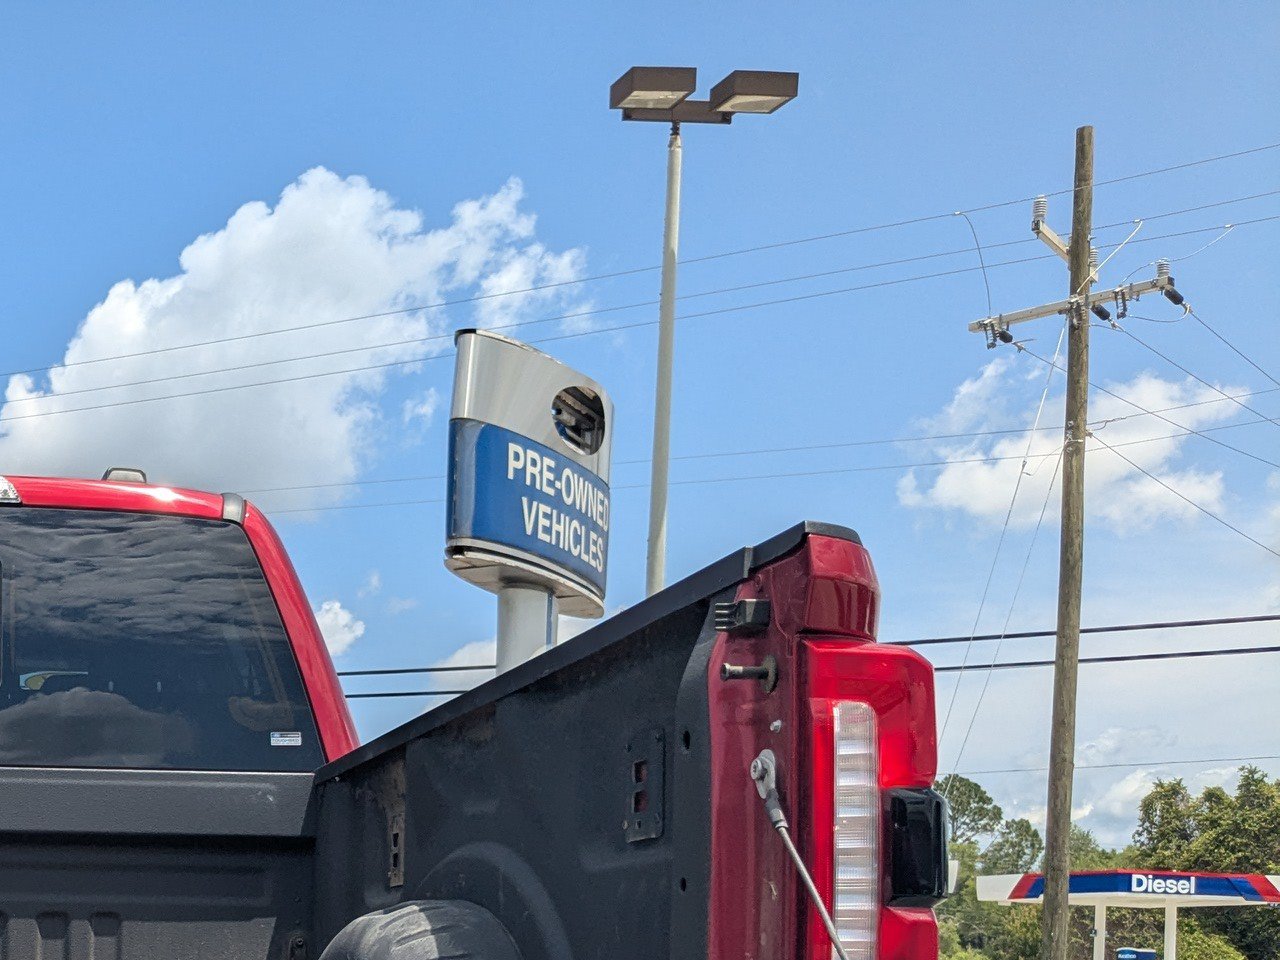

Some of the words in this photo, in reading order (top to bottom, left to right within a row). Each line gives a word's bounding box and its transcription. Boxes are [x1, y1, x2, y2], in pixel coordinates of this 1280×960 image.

[507, 442, 609, 532] PRE-OWNED
[522, 496, 603, 573] VEHICLES
[1131, 874, 1196, 894] Diesel
